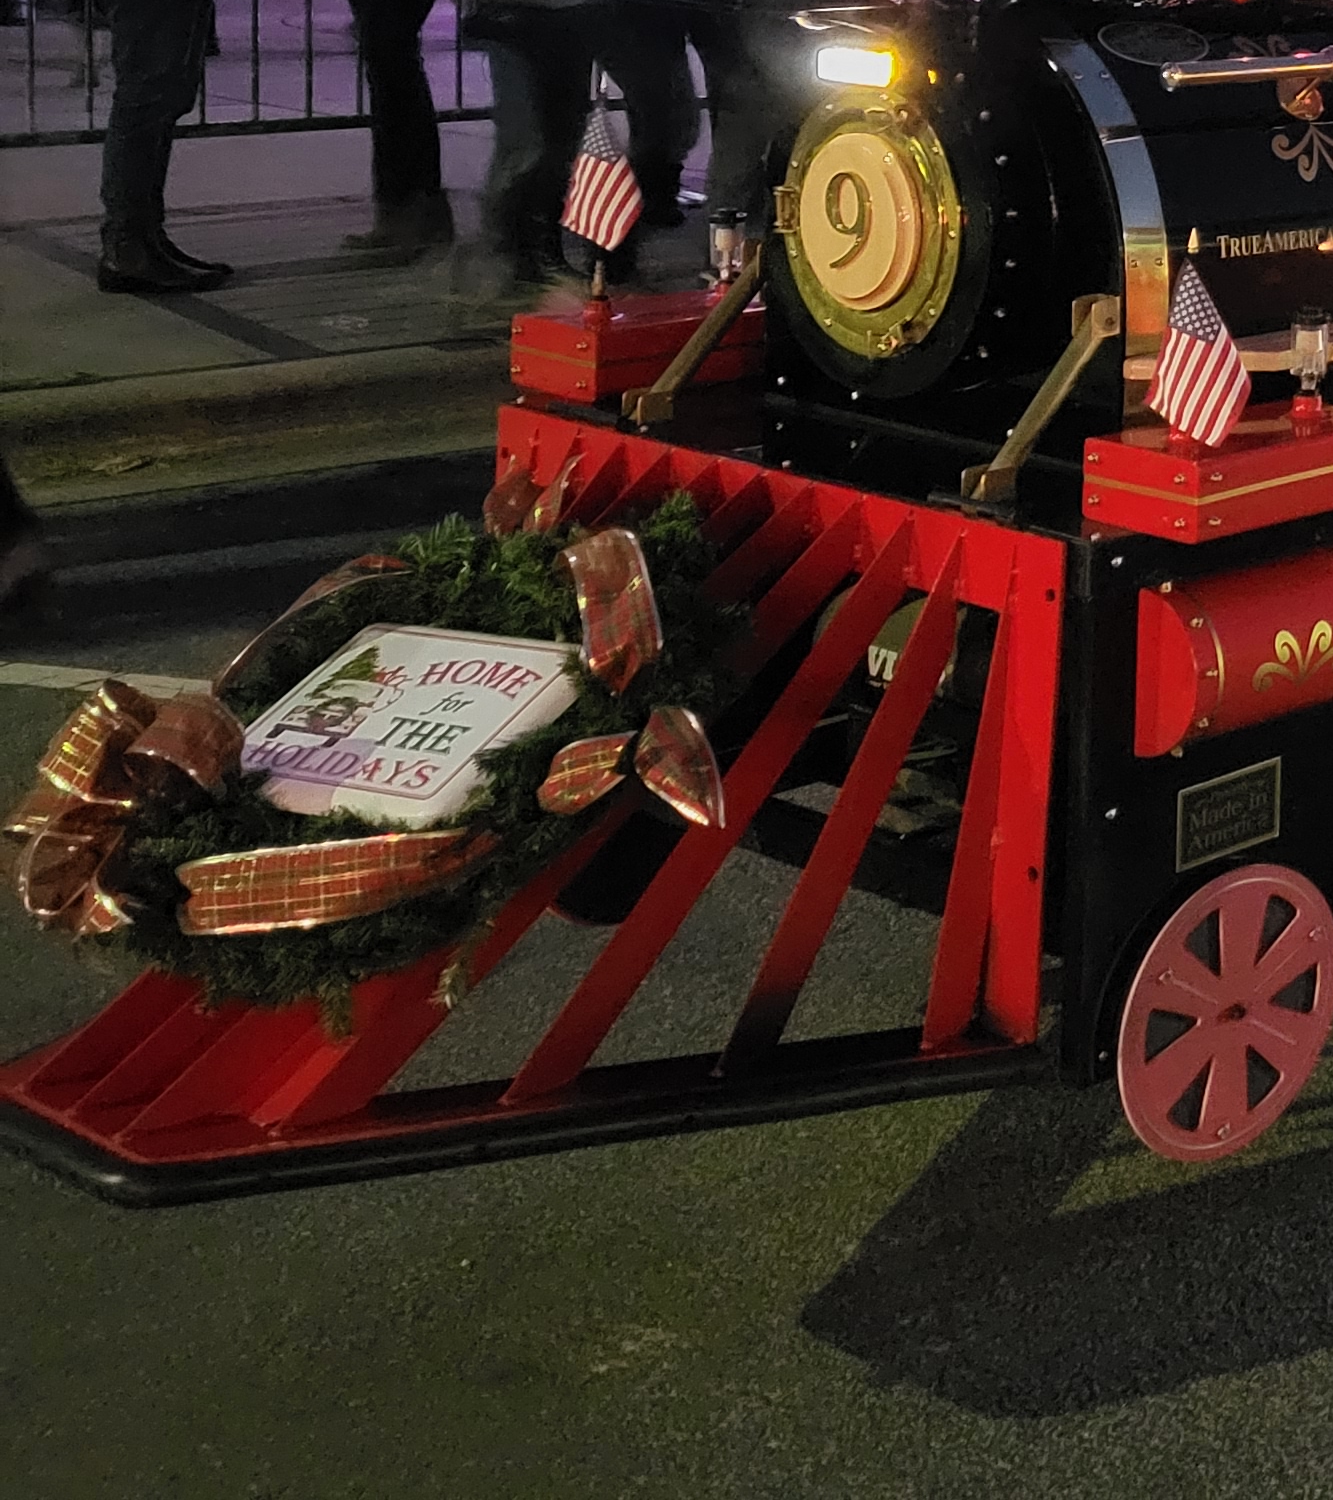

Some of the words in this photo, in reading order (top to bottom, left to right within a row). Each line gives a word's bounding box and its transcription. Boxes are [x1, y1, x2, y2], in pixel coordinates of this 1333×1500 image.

[824, 171, 873, 269] 9
[417, 659, 543, 699] HOME
[419, 691, 475, 716] for
[375, 716, 473, 755] THE
[244, 740, 441, 790] HOLIDAYS
[1190, 800, 1244, 834] Made
